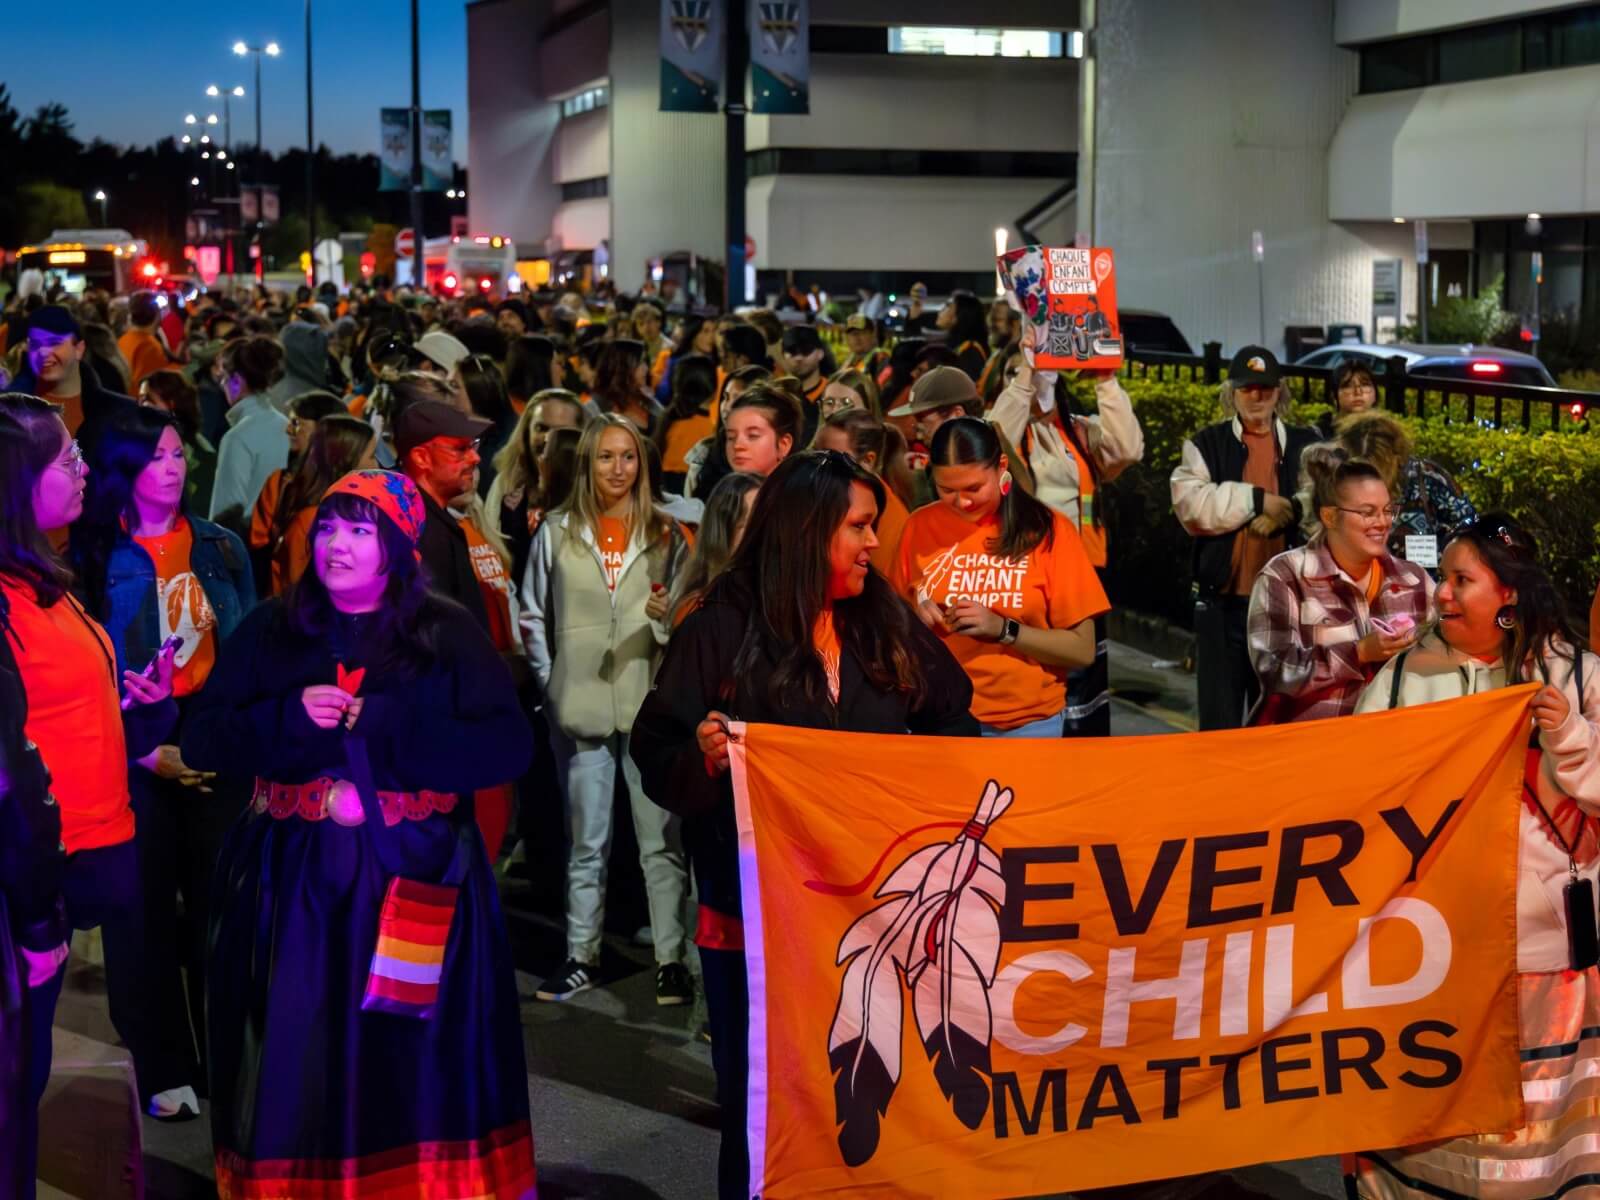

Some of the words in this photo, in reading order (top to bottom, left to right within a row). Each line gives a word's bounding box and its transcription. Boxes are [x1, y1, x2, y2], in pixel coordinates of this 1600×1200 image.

[1051, 250, 1087, 263] CHAQUE
[1054, 265, 1089, 278] ENFANT
[1053, 280, 1092, 293] COMPTE
[948, 568, 1027, 592] ENFANT
[1001, 798, 1464, 943] EVERY
[992, 897, 1453, 1056] CHILD
[991, 1020, 1464, 1139] MATTERS
